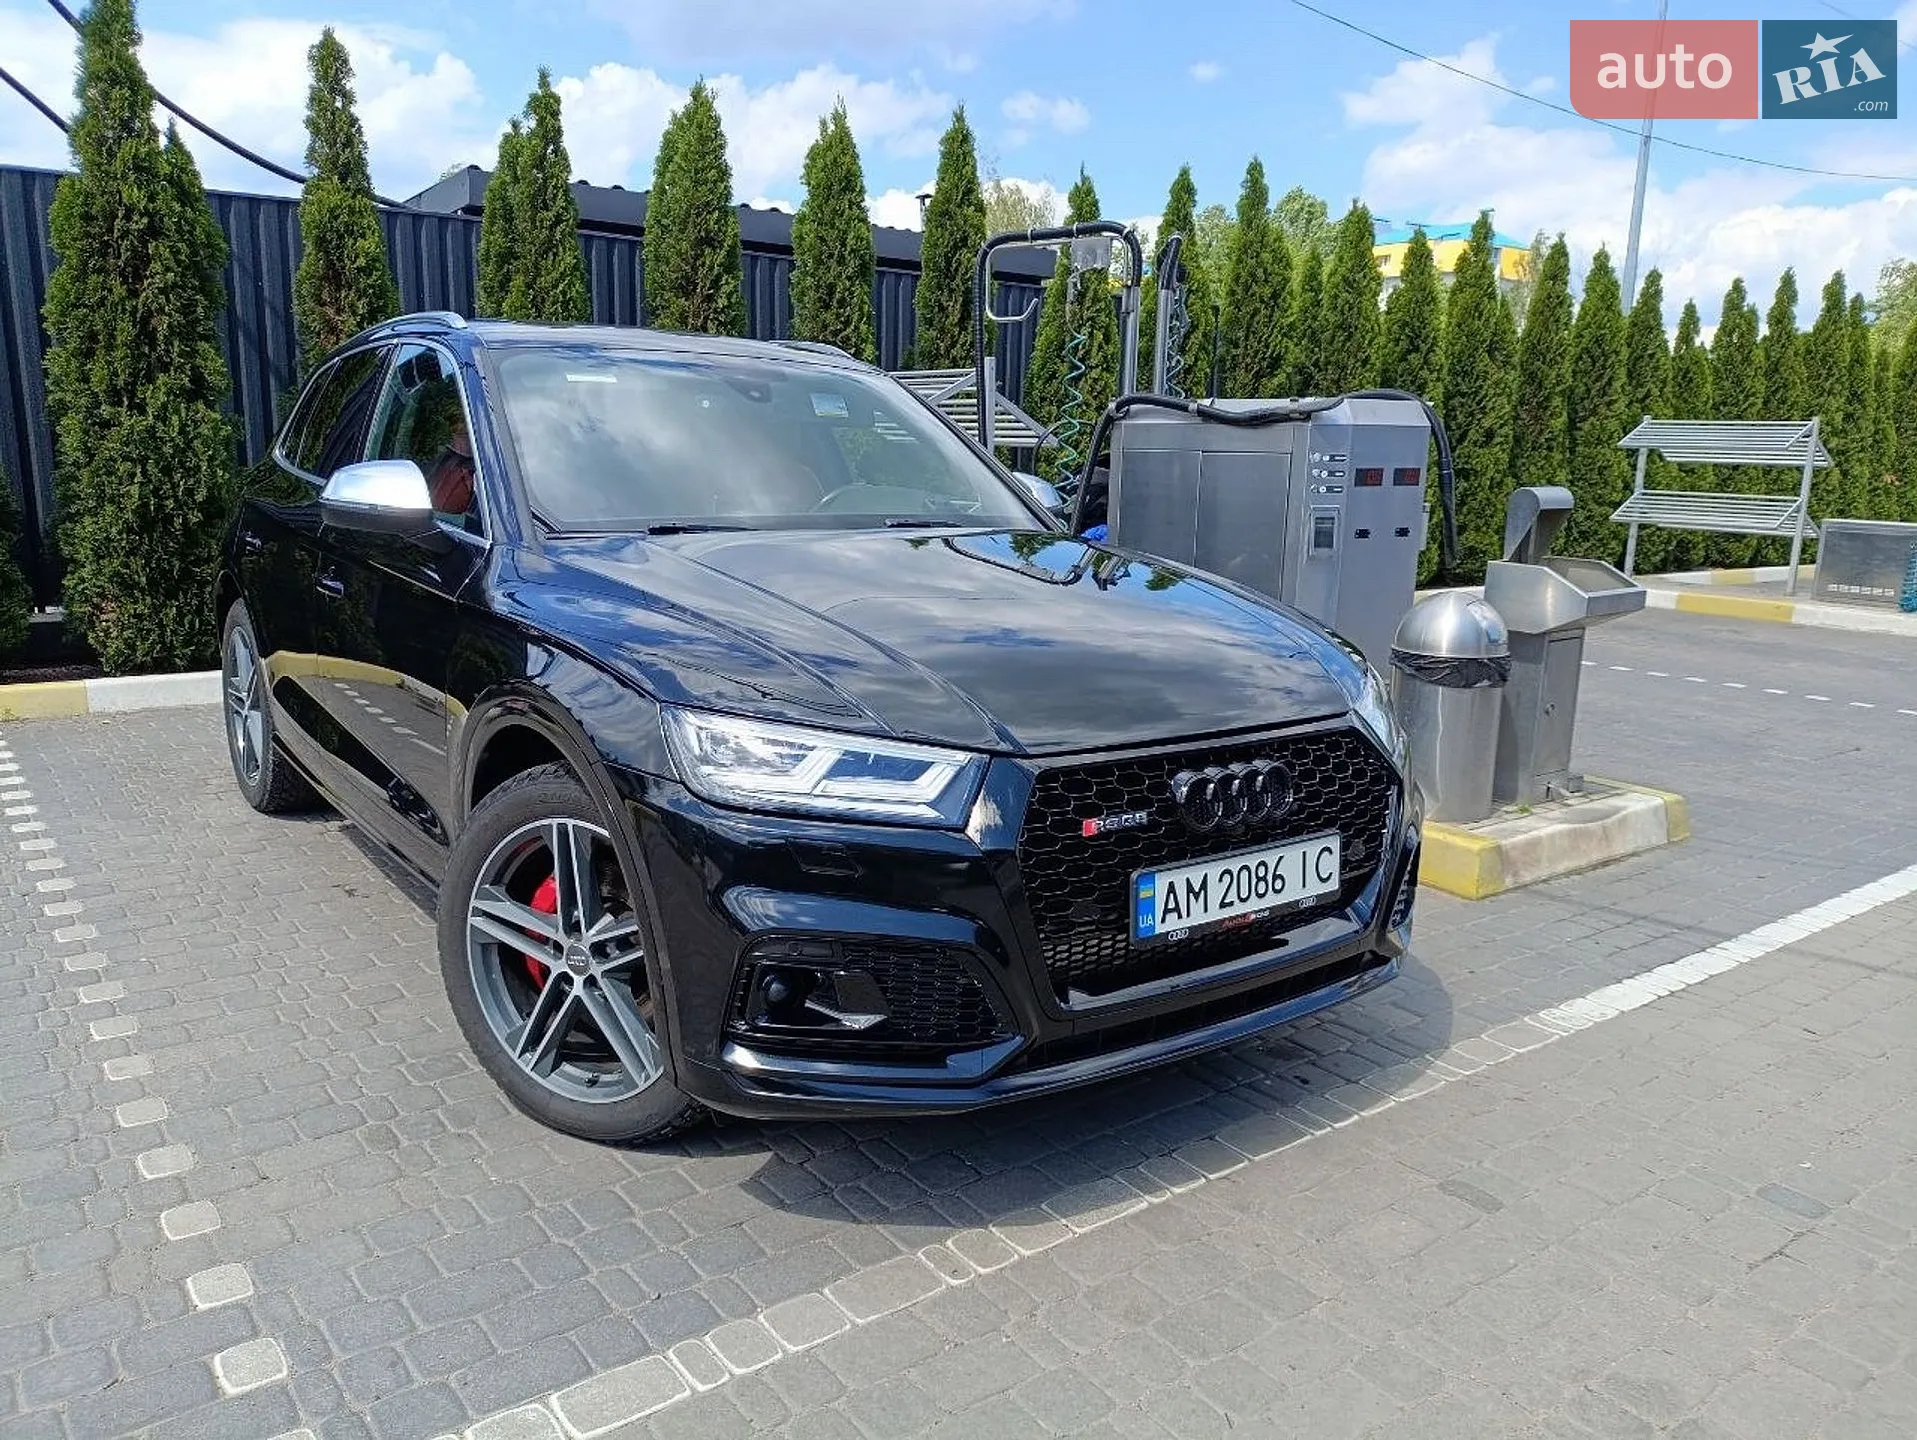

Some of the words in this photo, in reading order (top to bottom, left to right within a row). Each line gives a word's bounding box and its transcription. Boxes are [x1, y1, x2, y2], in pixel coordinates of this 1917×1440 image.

[1160, 873, 1209, 924] AM
[1218, 855, 1286, 910] 2086
[1301, 846, 1333, 889] IC
[1139, 913, 1154, 928] UA
